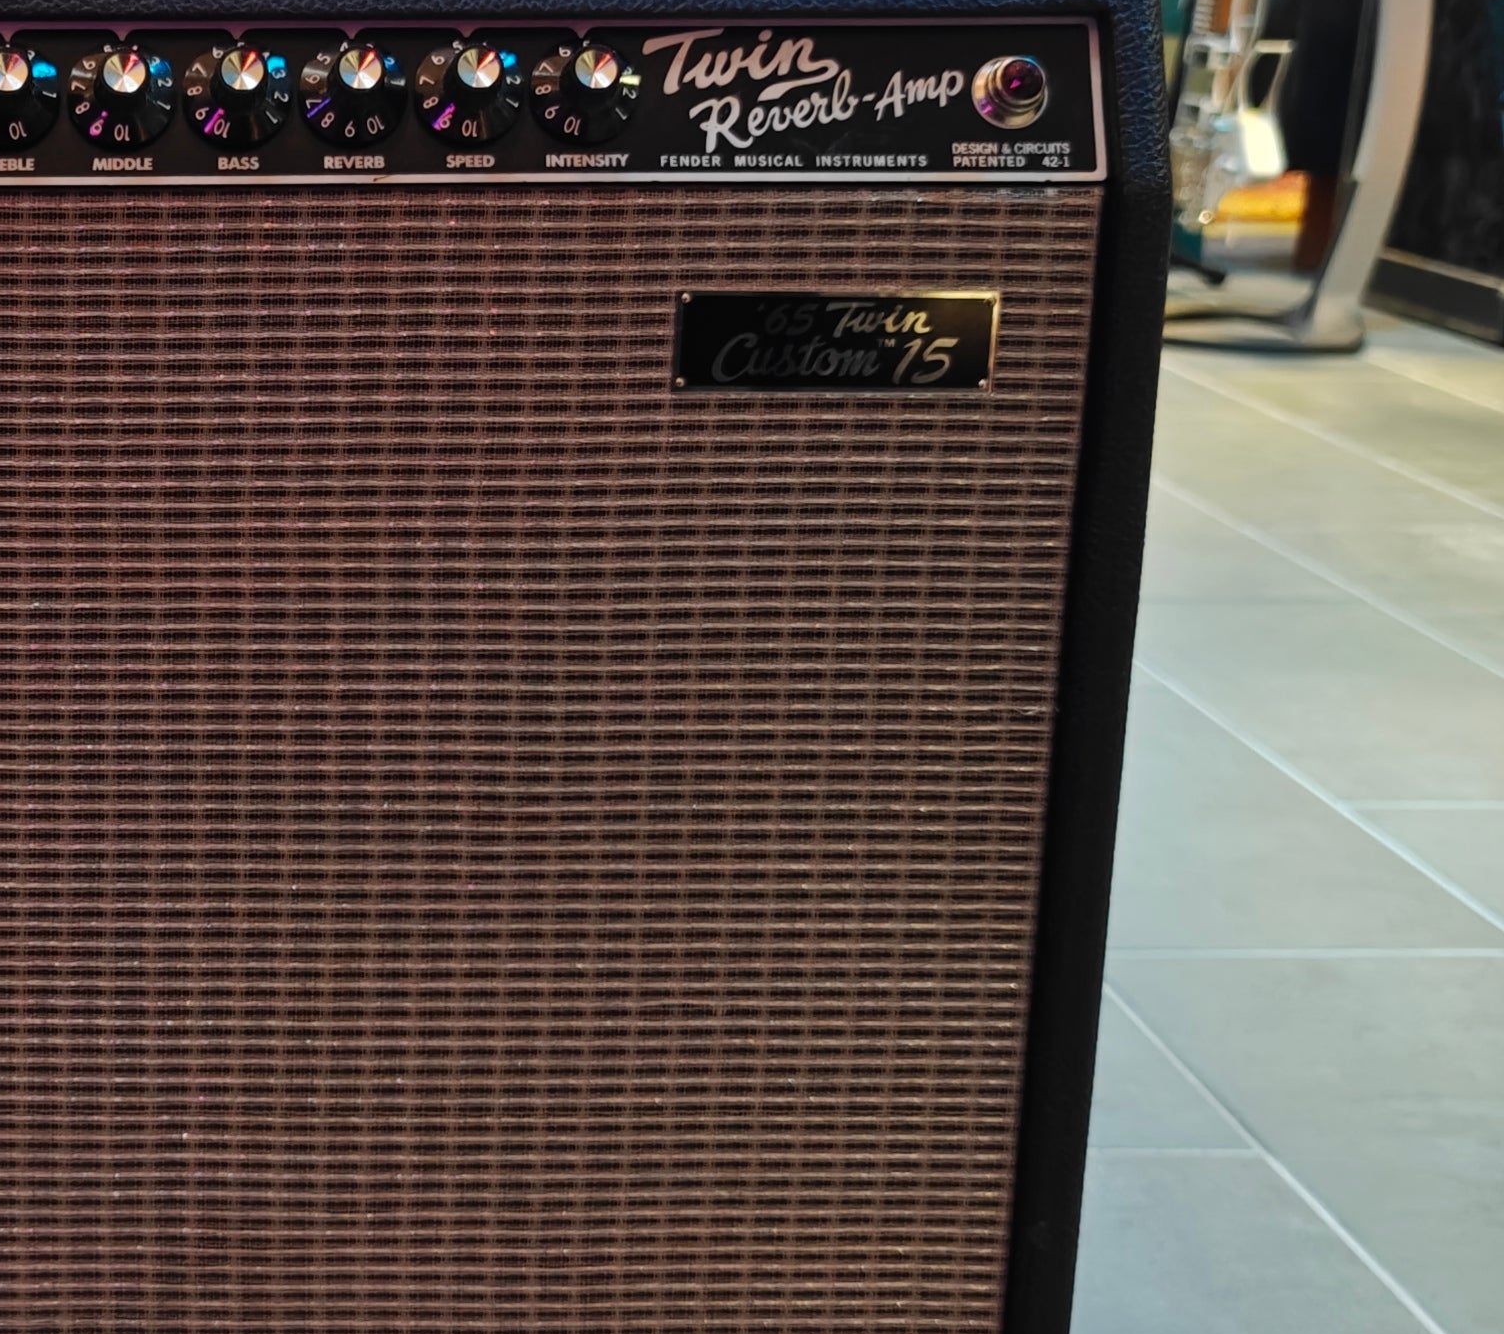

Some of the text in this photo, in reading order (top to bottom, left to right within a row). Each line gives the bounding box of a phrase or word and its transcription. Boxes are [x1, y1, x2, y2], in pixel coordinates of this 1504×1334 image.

[82, 59, 96, 70] 6
[317, 53, 331, 65] 5
[431, 55, 445, 65] 6
[642, 28, 841, 102] Twin
[191, 63, 207, 77] 7
[538, 61, 554, 73] 7
[272, 69, 286, 79] 3
[305, 74, 320, 84] 6
[419, 75, 435, 85] 7
[506, 75, 521, 85] 2
[71, 81, 86, 91] 7
[158, 78, 172, 87] 2
[187, 86, 202, 96] 8
[535, 84, 552, 95] 8
[622, 87, 637, 99] 2
[274, 91, 289, 103] 2
[423, 96, 439, 109] 8
[505, 98, 519, 108] 1
[75, 101, 90, 115] 8
[157, 100, 171, 110] 1
[306, 99, 322, 109] 7
[195, 107, 210, 121] 9
[265, 110, 278, 124] 1
[544, 105, 560, 119] 9
[615, 108, 628, 120] 1
[321, 112, 334, 128] 8
[366, 115, 385, 134] 10
[563, 116, 581, 136] 10
[8, 121, 27, 140] 10
[114, 123, 130, 141] 10
[213, 119, 231, 139] 10
[344, 120, 355, 138] 9
[462, 119, 477, 138] 10
[952, 143, 1070, 155] DESIGN & CIRCUITS
[92, 157, 153, 171] MIDDLE
[218, 157, 260, 171] BASS
[324, 155, 386, 169] REVERB
[446, 155, 496, 168] SPEED
[546, 154, 629, 167] INTENSITY
[660, 155, 928, 167] FENDER MUSICAL INSTRUMENTS
[953, 156, 1070, 167] PATENTED 42-1
[824, 300, 935, 339] Twin
[892, 337, 959, 385] 15
